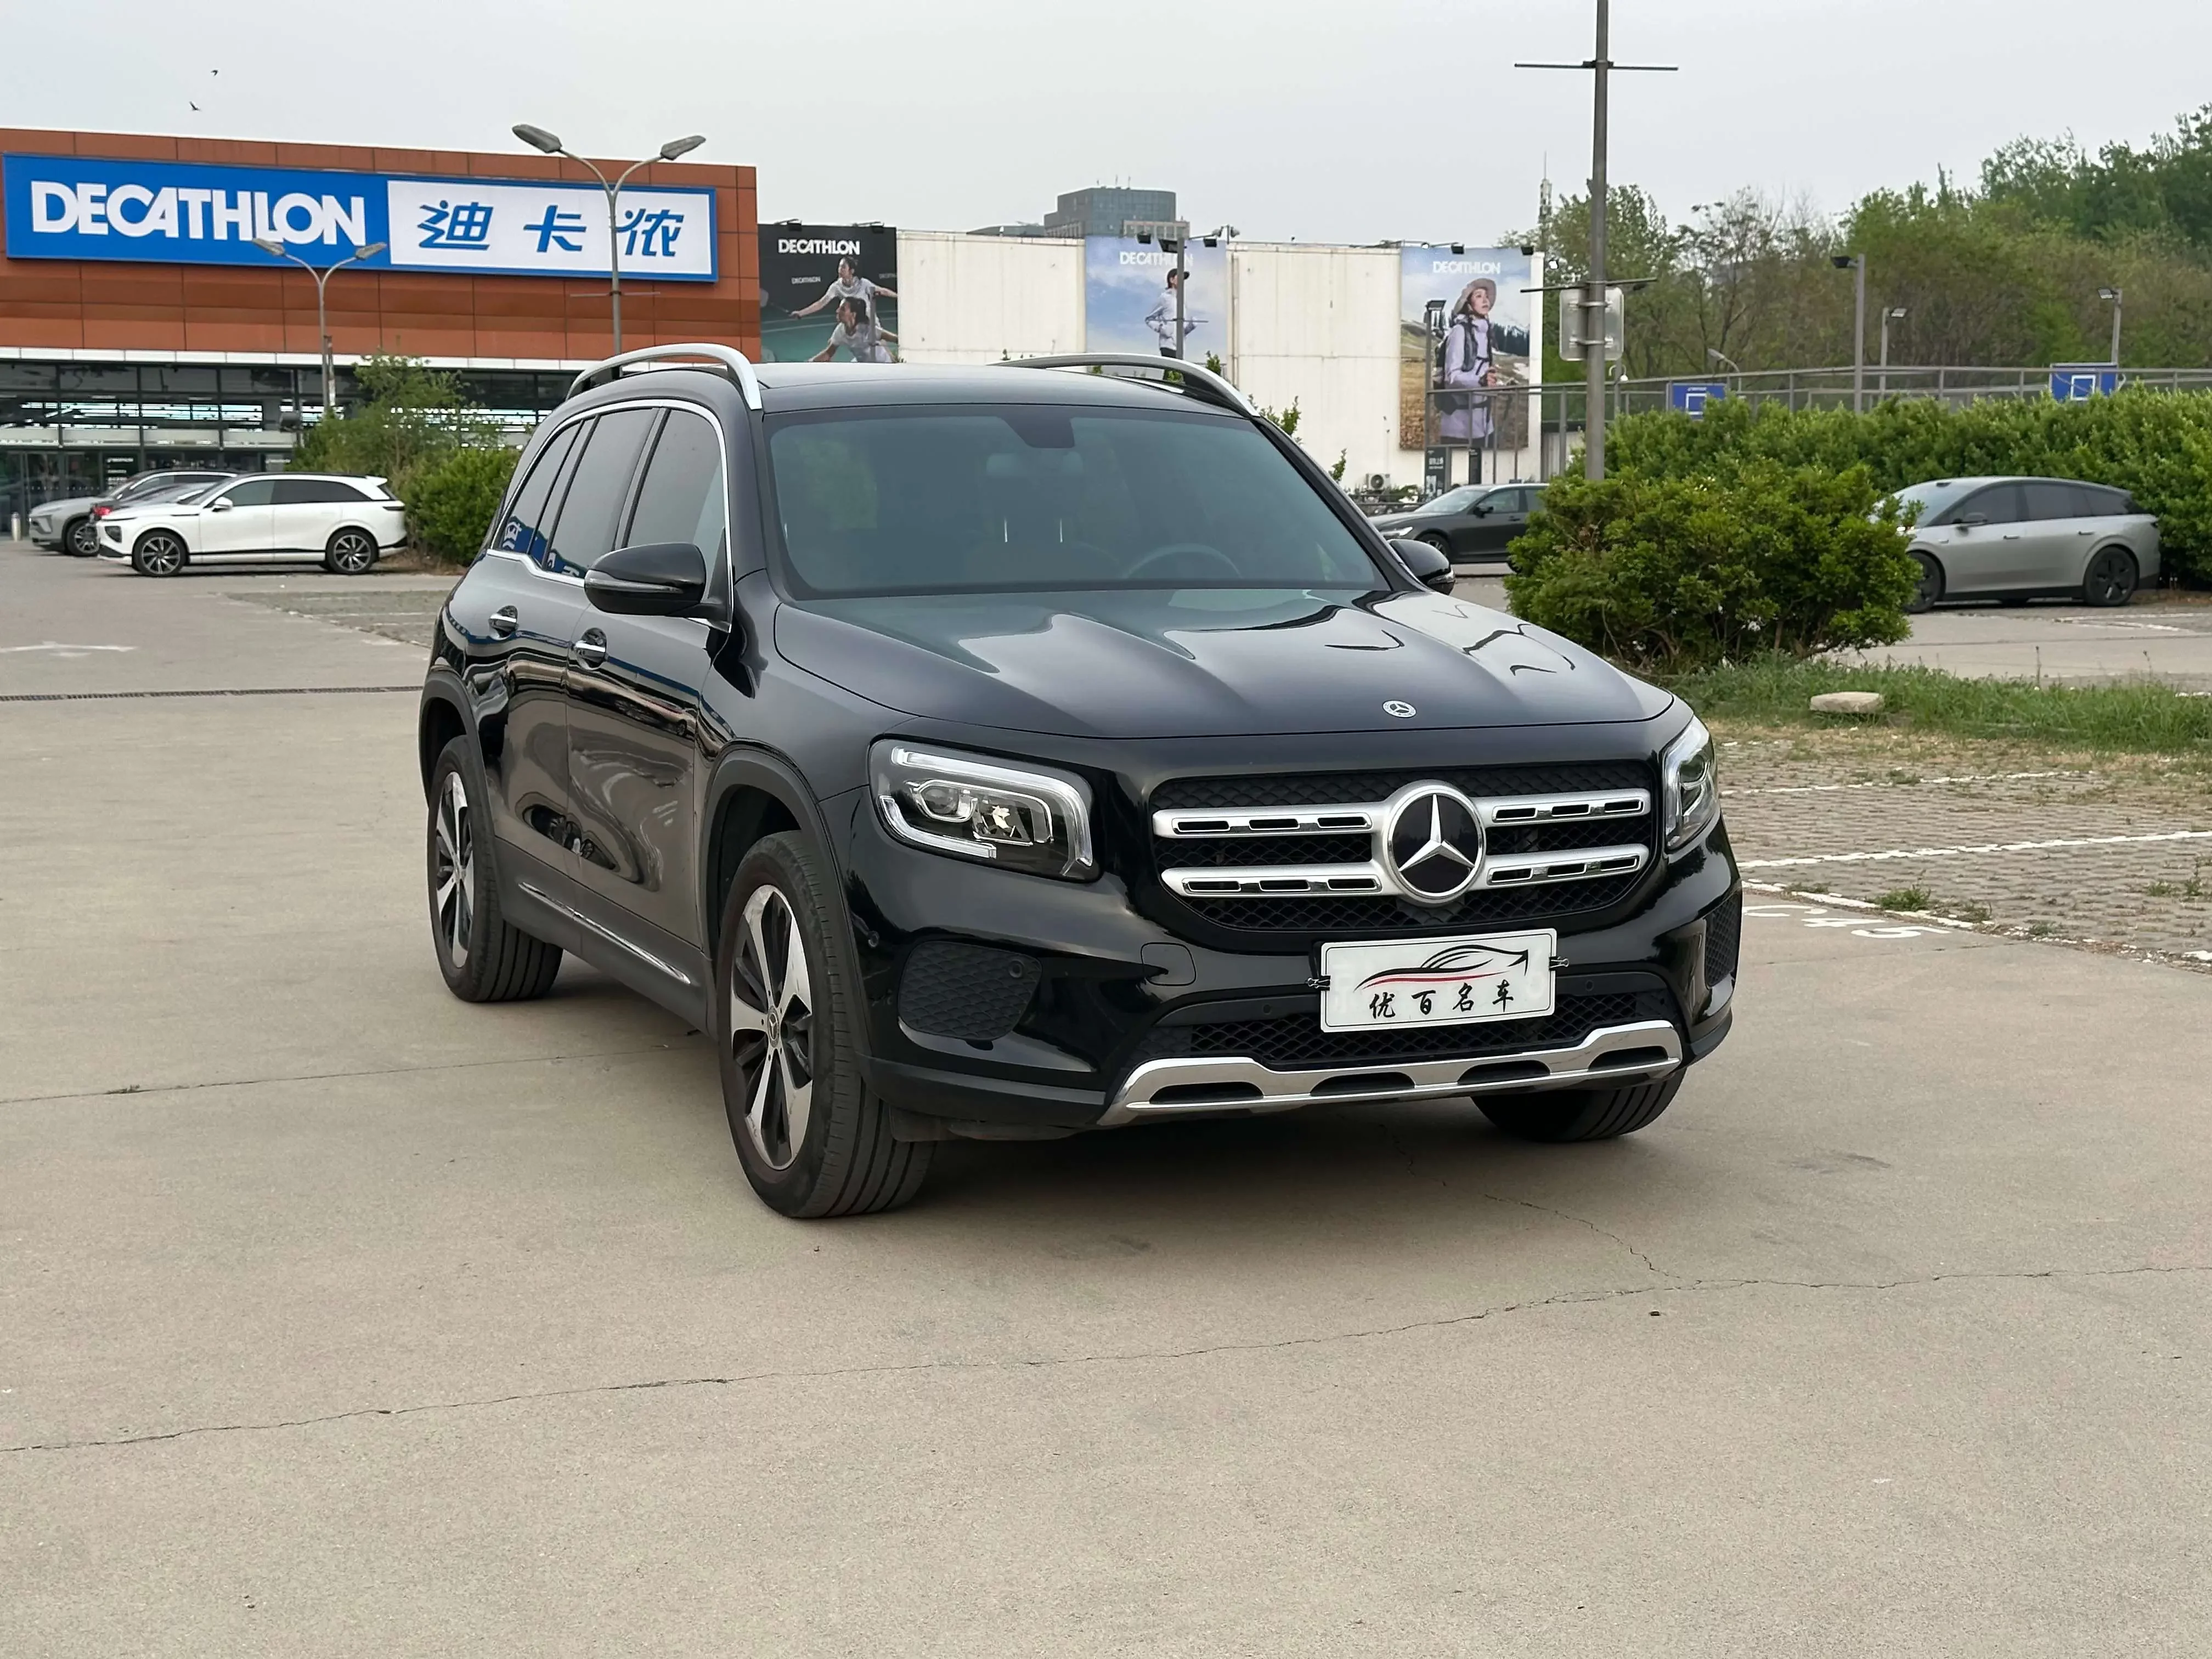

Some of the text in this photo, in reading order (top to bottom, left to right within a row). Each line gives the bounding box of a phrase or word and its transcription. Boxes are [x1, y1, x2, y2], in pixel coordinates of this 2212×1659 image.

[31, 180, 366, 246] DECATHLON
[417, 199, 684, 257] 迪卡侬
[778, 239, 860, 255] DECATHLON
[1432, 261, 1501, 274] DECATHLON
[1369, 979, 1514, 1019] 优百名车
